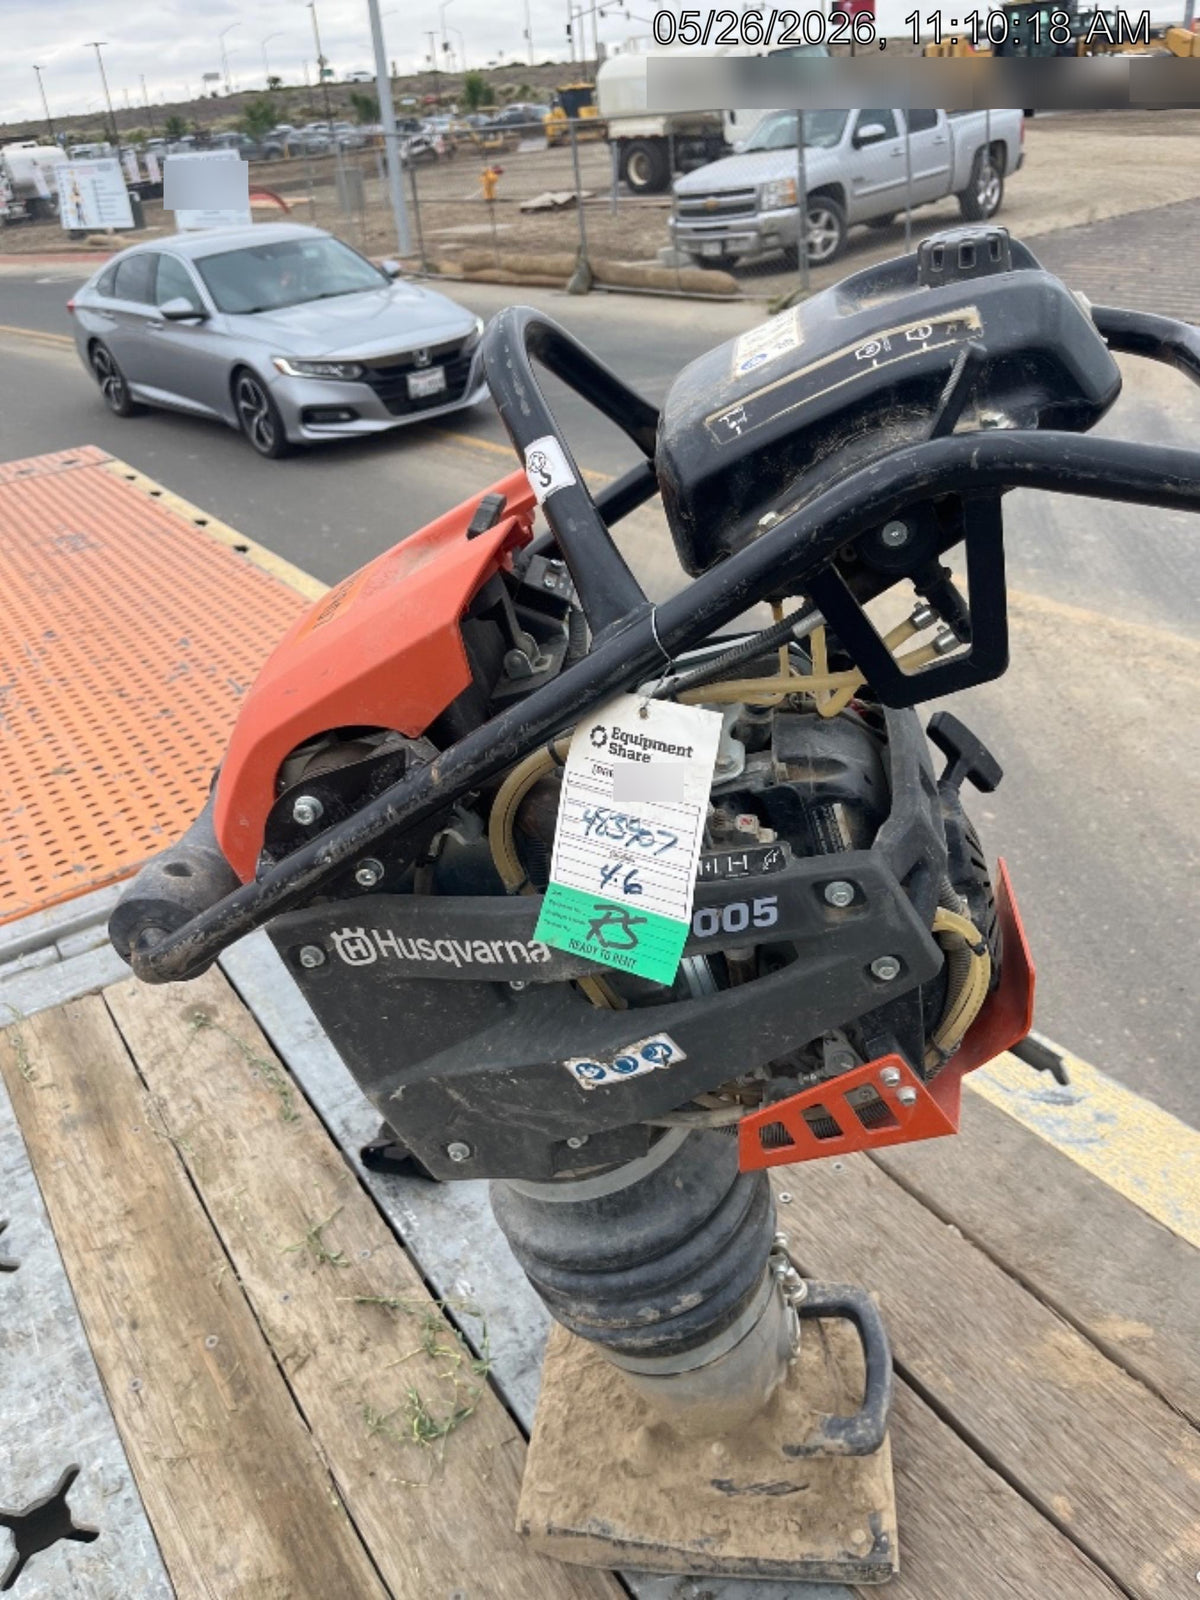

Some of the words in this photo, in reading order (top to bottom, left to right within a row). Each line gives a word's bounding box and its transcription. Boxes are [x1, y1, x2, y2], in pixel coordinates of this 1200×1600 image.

[608, 742, 652, 763] Share
[611, 726, 693, 758] Equipment
[600, 864, 643, 894] 4.6
[371, 928, 551, 968] Husqvarna
[568, 938, 598, 955] READY
[600, 949, 611, 961] TO
